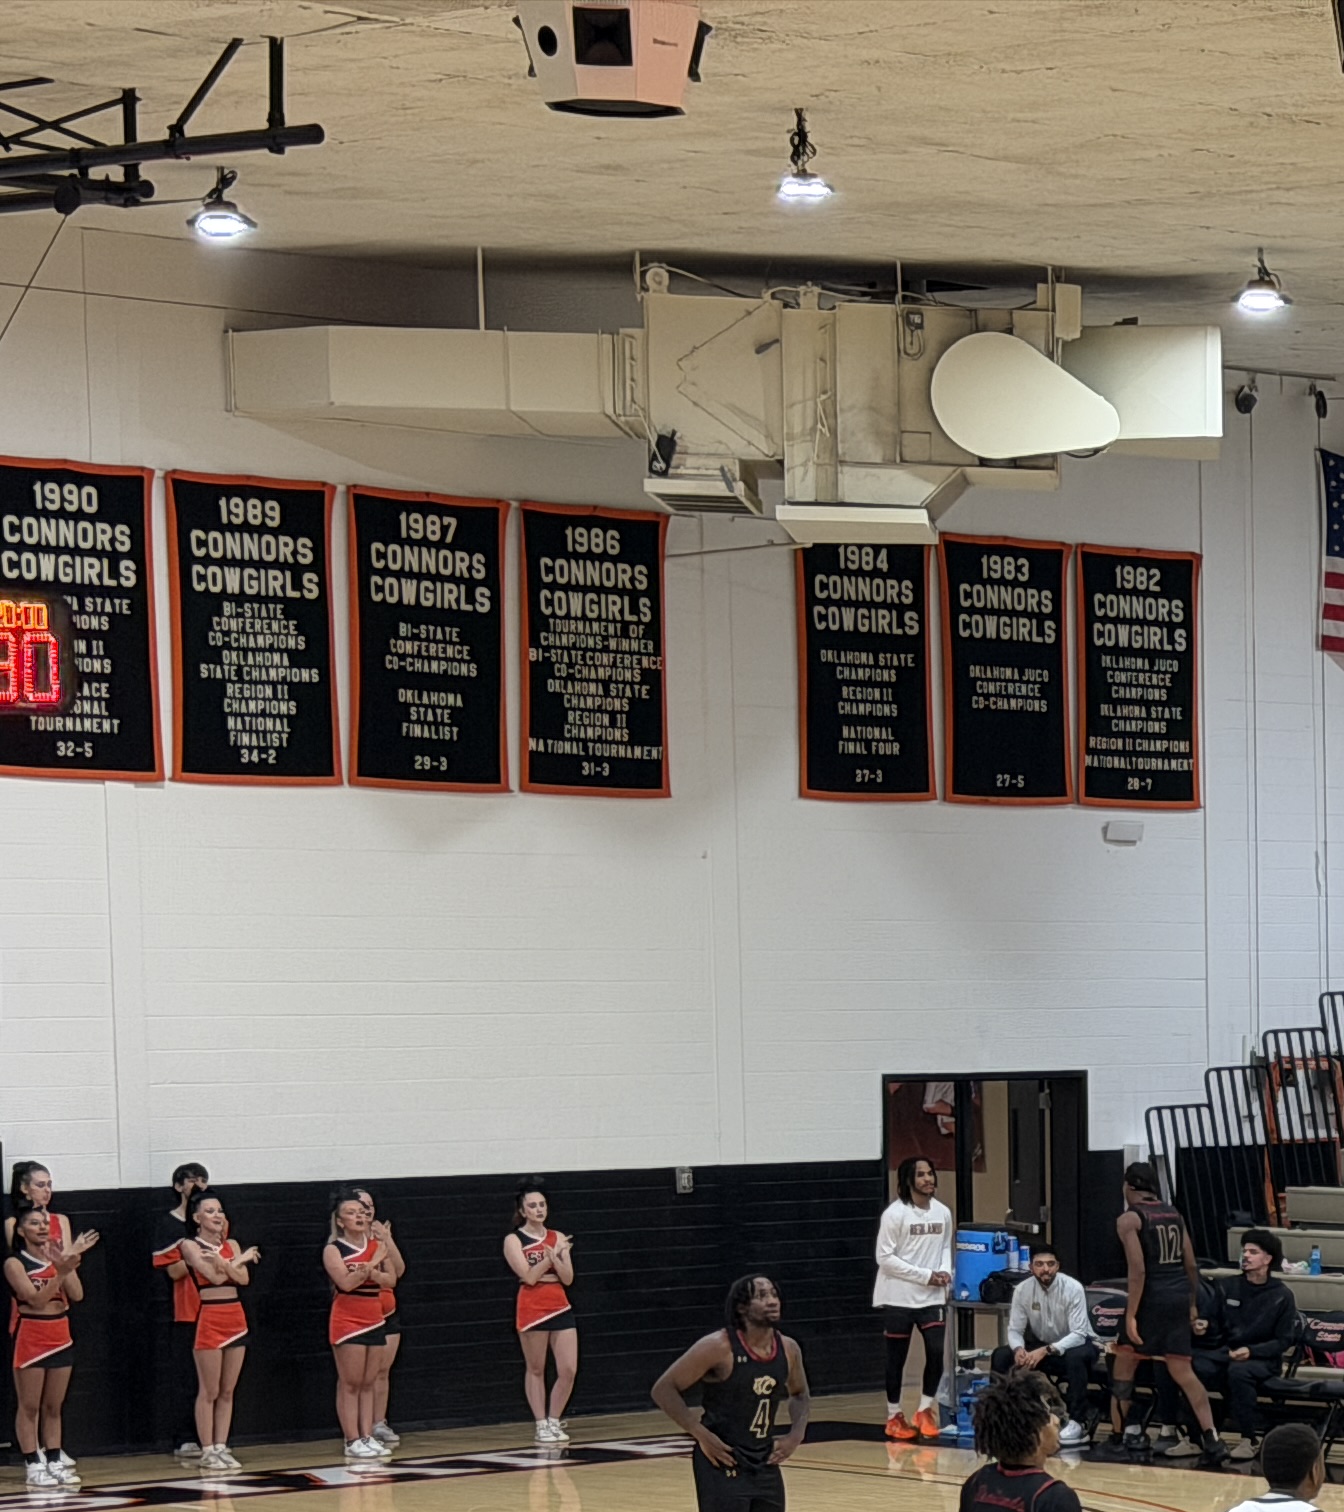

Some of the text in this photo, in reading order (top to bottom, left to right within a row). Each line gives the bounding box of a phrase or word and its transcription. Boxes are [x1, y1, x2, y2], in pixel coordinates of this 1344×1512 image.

[33, 481, 98, 513] 1990
[218, 496, 280, 528] 1989
[2, 515, 131, 552] CONNORS
[399, 512, 458, 544] 1987
[190, 529, 314, 564] CONNORS
[565, 526, 620, 555] 1986
[1, 551, 137, 588] COWGIRLS
[370, 542, 486, 580] CONNORS
[838, 545, 888, 572] 1984
[981, 554, 1029, 582] 1983
[192, 564, 319, 600] COWGIRLS
[540, 556, 648, 590] CONNORS
[1115, 564, 1161, 592] 1982
[370, 576, 491, 613] COWGIRLS
[814, 574, 914, 604] CONNORS
[959, 583, 1052, 614] CONNORS
[223, 601, 284, 619] BI-STATE
[539, 589, 652, 622] COWGIRLS
[1094, 593, 1184, 622] CONNORS
[212, 616, 298, 634] CONFERENCE
[399, 622, 460, 642] BI-STATE
[548, 618, 646, 638] TOURNAMENT OF
[813, 605, 920, 636] COWGIRLS
[958, 614, 1056, 644] COWGIRLS
[208, 632, 306, 650] CO-CHAMPIONS
[390, 638, 471, 660] CONFERENCE
[1093, 623, 1187, 652] COWGIRLS
[222, 650, 290, 666] OKLAHOMA
[385, 655, 478, 677] CO-CHAMPIONS
[200, 663, 320, 683] STATE CHAMPIONS
[226, 683, 272, 698] REGION
[398, 688, 463, 708] OKLAHOMA
[610, 684, 650, 699] STATE
[224, 698, 297, 715] CHAMPIONS
[410, 706, 452, 723] STATE
[564, 695, 630, 712] CHAMPIONS
[30, 715, 120, 734] TOURNAMENT
[227, 716, 291, 732] NATIONAL
[568, 710, 610, 727] REGION
[230, 732, 288, 748] FINALIST
[402, 722, 459, 741] FINALIST
[564, 724, 629, 742] CHAMPIONS
[57, 741, 93, 758] 32-5
[750, 1398, 770, 1438] 4
